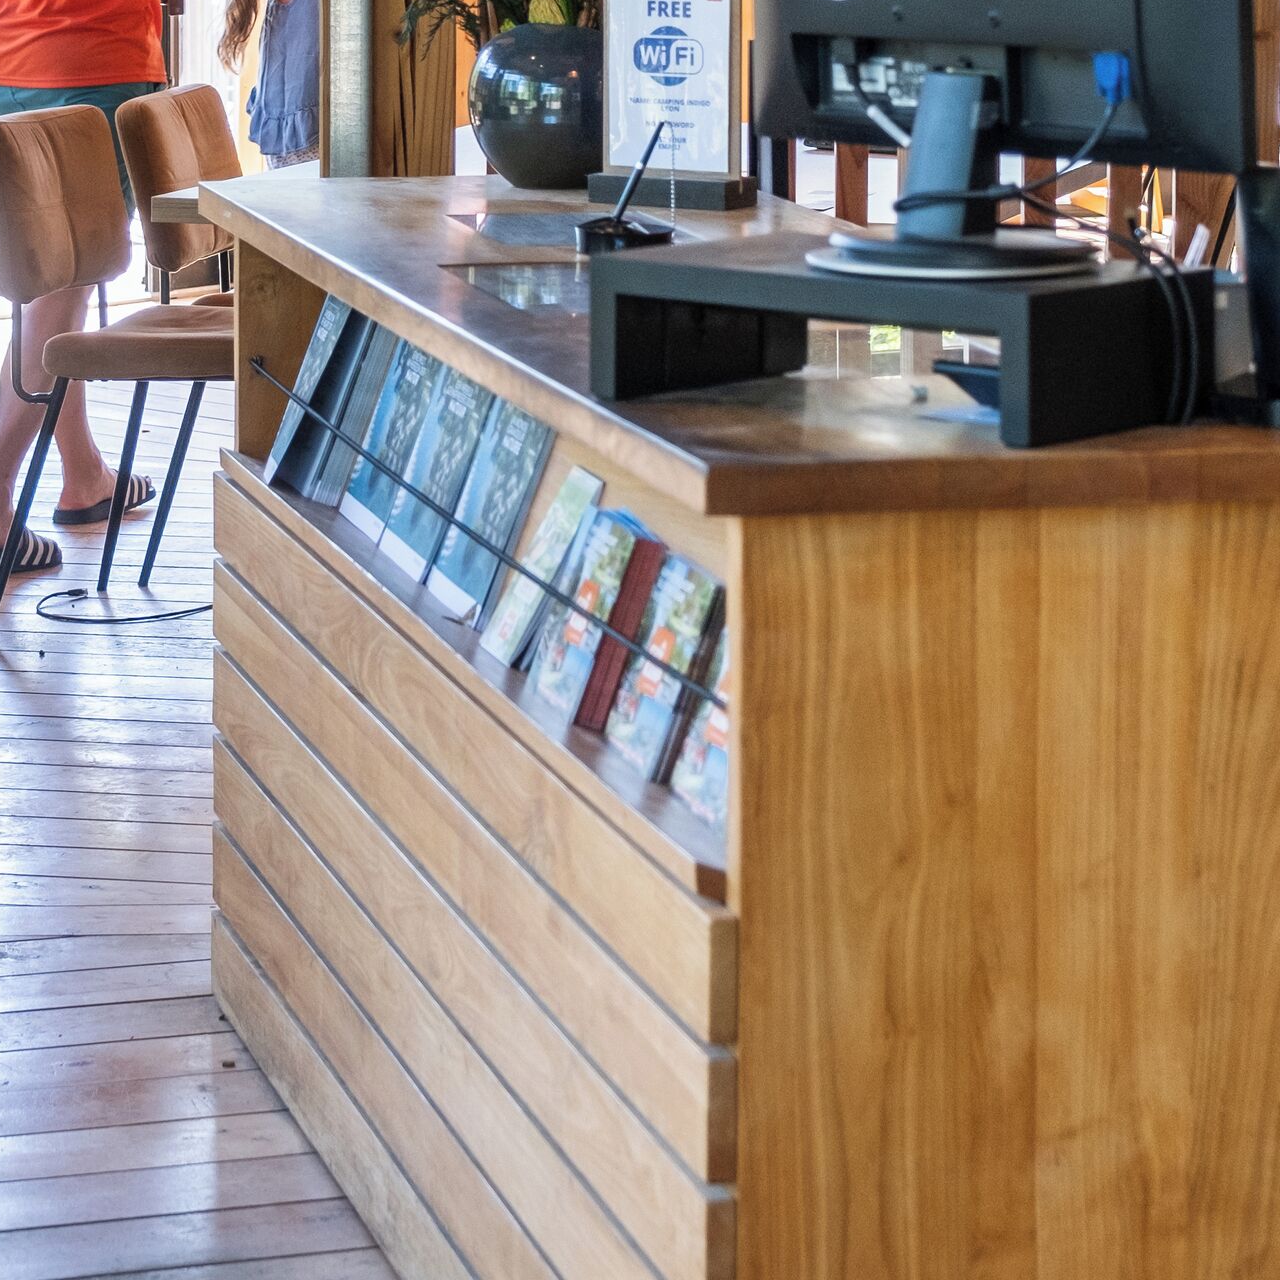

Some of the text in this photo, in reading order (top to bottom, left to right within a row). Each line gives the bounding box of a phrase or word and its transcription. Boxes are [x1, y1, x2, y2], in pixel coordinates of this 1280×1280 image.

[647, 0, 692, 18] FREE
[654, 98, 685, 106] CAMPING
[687, 99, 711, 107] INDIGO
